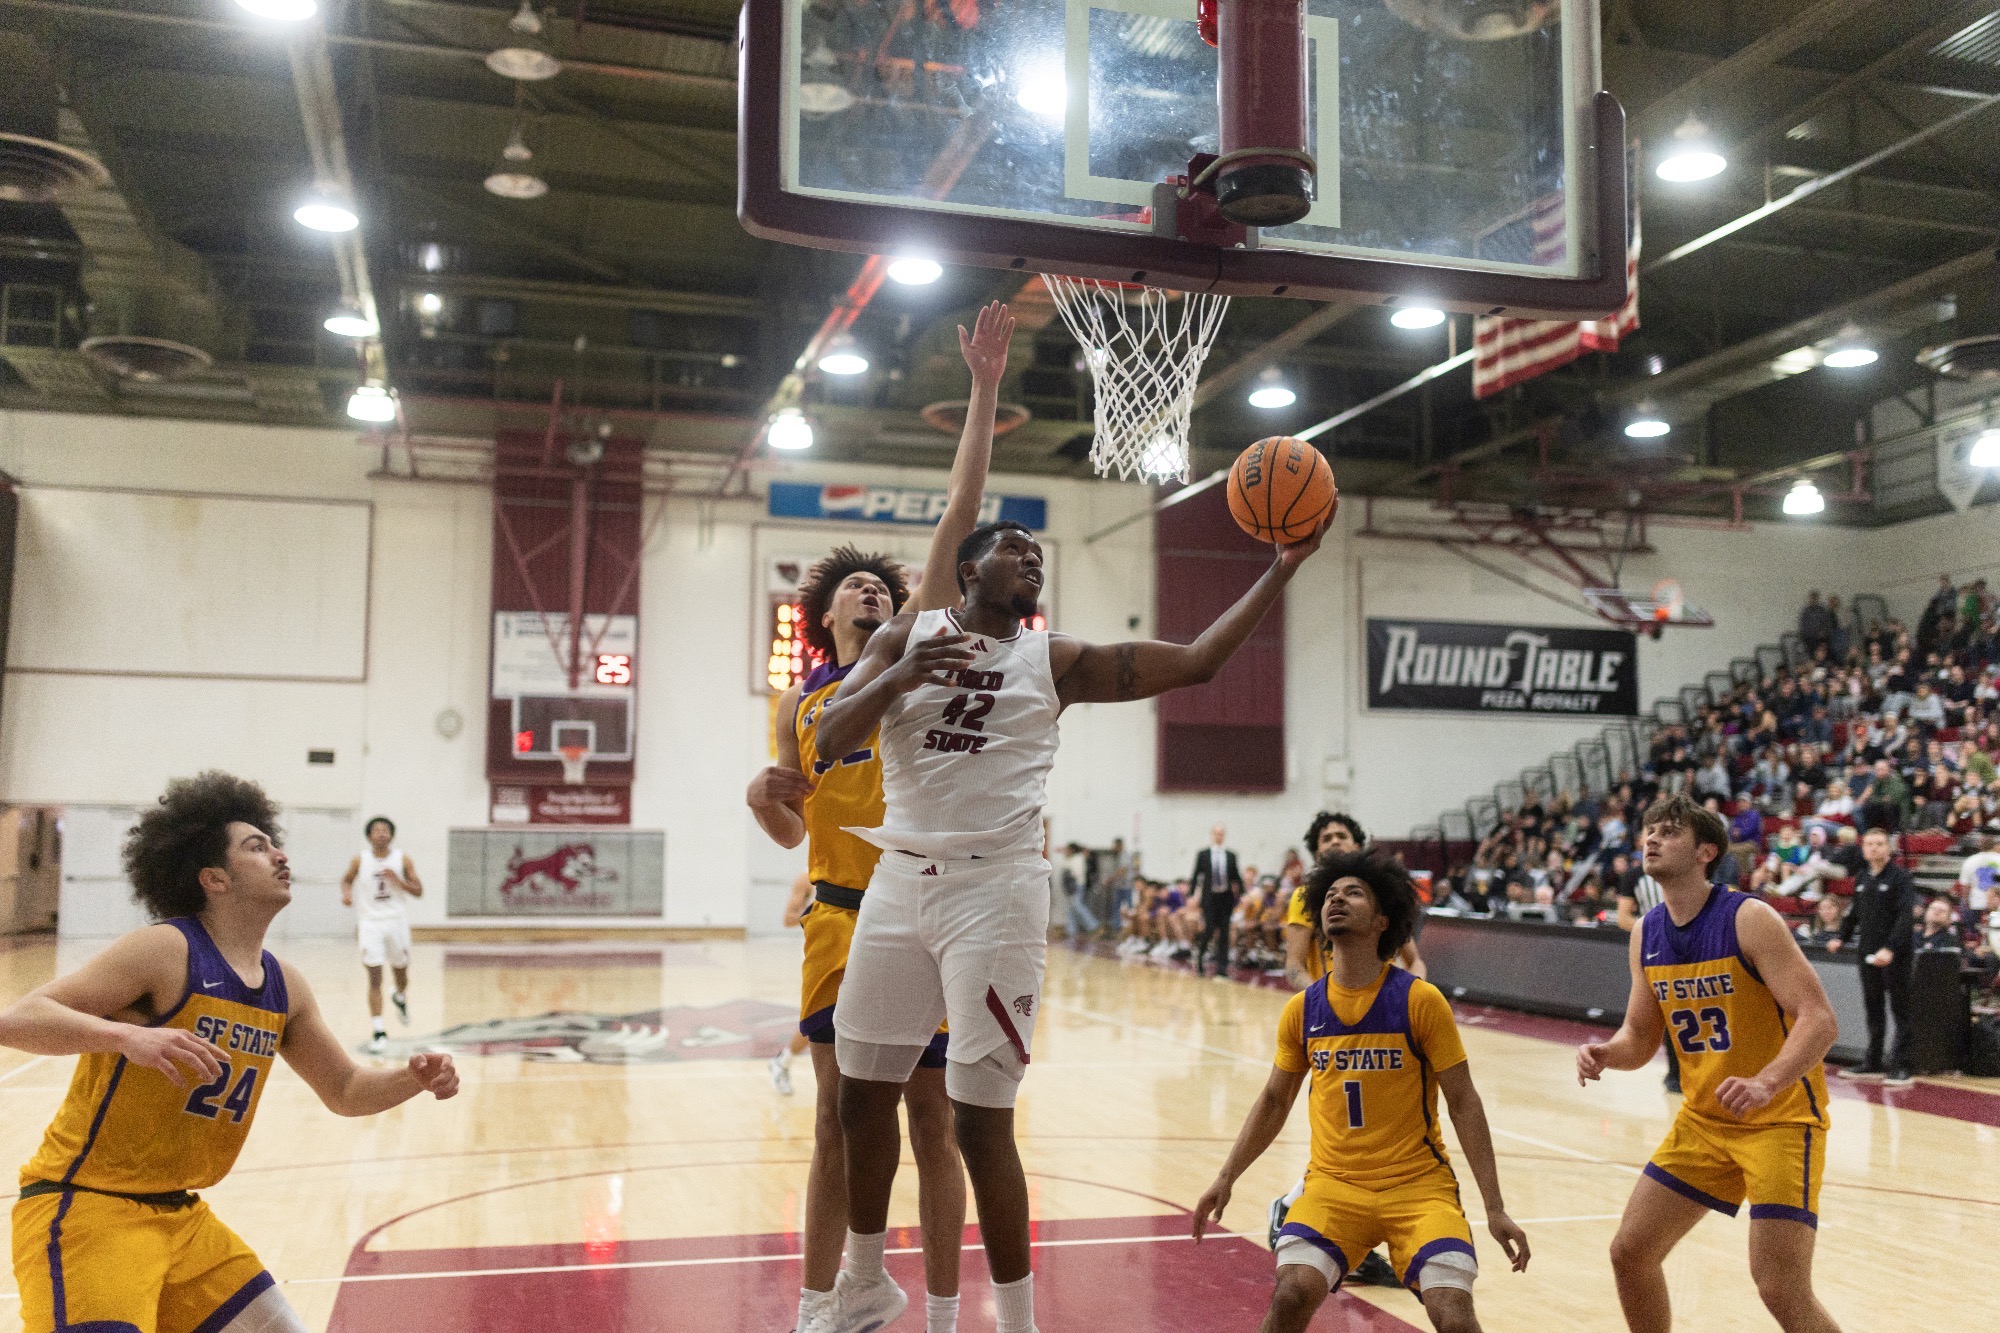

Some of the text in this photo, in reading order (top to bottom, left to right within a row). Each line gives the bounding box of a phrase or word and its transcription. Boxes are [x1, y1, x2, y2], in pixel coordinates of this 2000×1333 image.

[863, 490, 1001, 523] PEPI
[596, 654, 631, 684] 25
[1380, 626, 1624, 697] ROUND TABLE
[942, 693, 996, 732] 42
[1480, 689, 1600, 712] PIZZA ROYALTY
[922, 729, 989, 755] STATE
[1672, 973, 1735, 1000] STATE
[194, 1015, 278, 1058] SF STATE
[1670, 1005, 1732, 1054] 23
[1312, 1048, 1404, 1071] SF STATE
[183, 1060, 259, 1123] 24
[1343, 1080, 1365, 1129] 1
